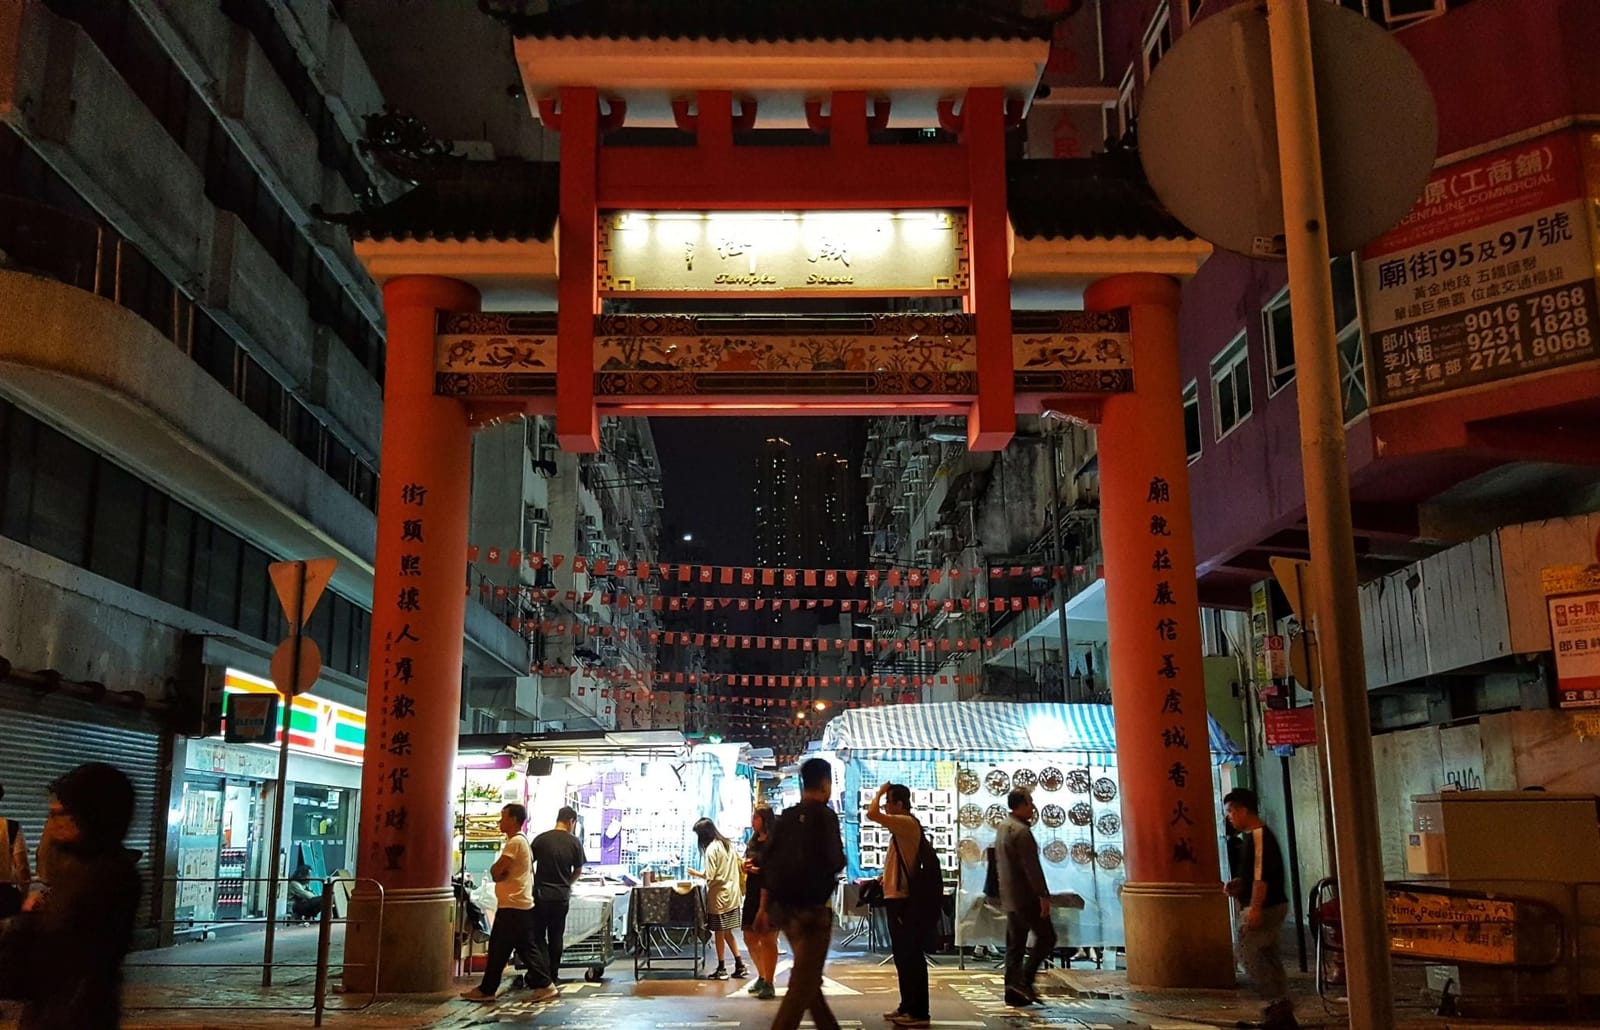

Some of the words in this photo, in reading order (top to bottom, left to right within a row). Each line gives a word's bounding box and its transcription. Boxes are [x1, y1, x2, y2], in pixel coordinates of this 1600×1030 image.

[1378, 212, 1573, 291] 廟街95及97號
[713, 272, 776, 287] Temple
[807, 273, 855, 286] Street
[1464, 303, 1521, 332] 9016
[1526, 287, 1587, 317] 7968
[1467, 322, 1521, 352] 9231
[1530, 306, 1589, 337] 1828
[1469, 343, 1525, 372] 2721
[1532, 327, 1592, 358] 8068
[1420, 906, 1481, 924] Pedestrian
